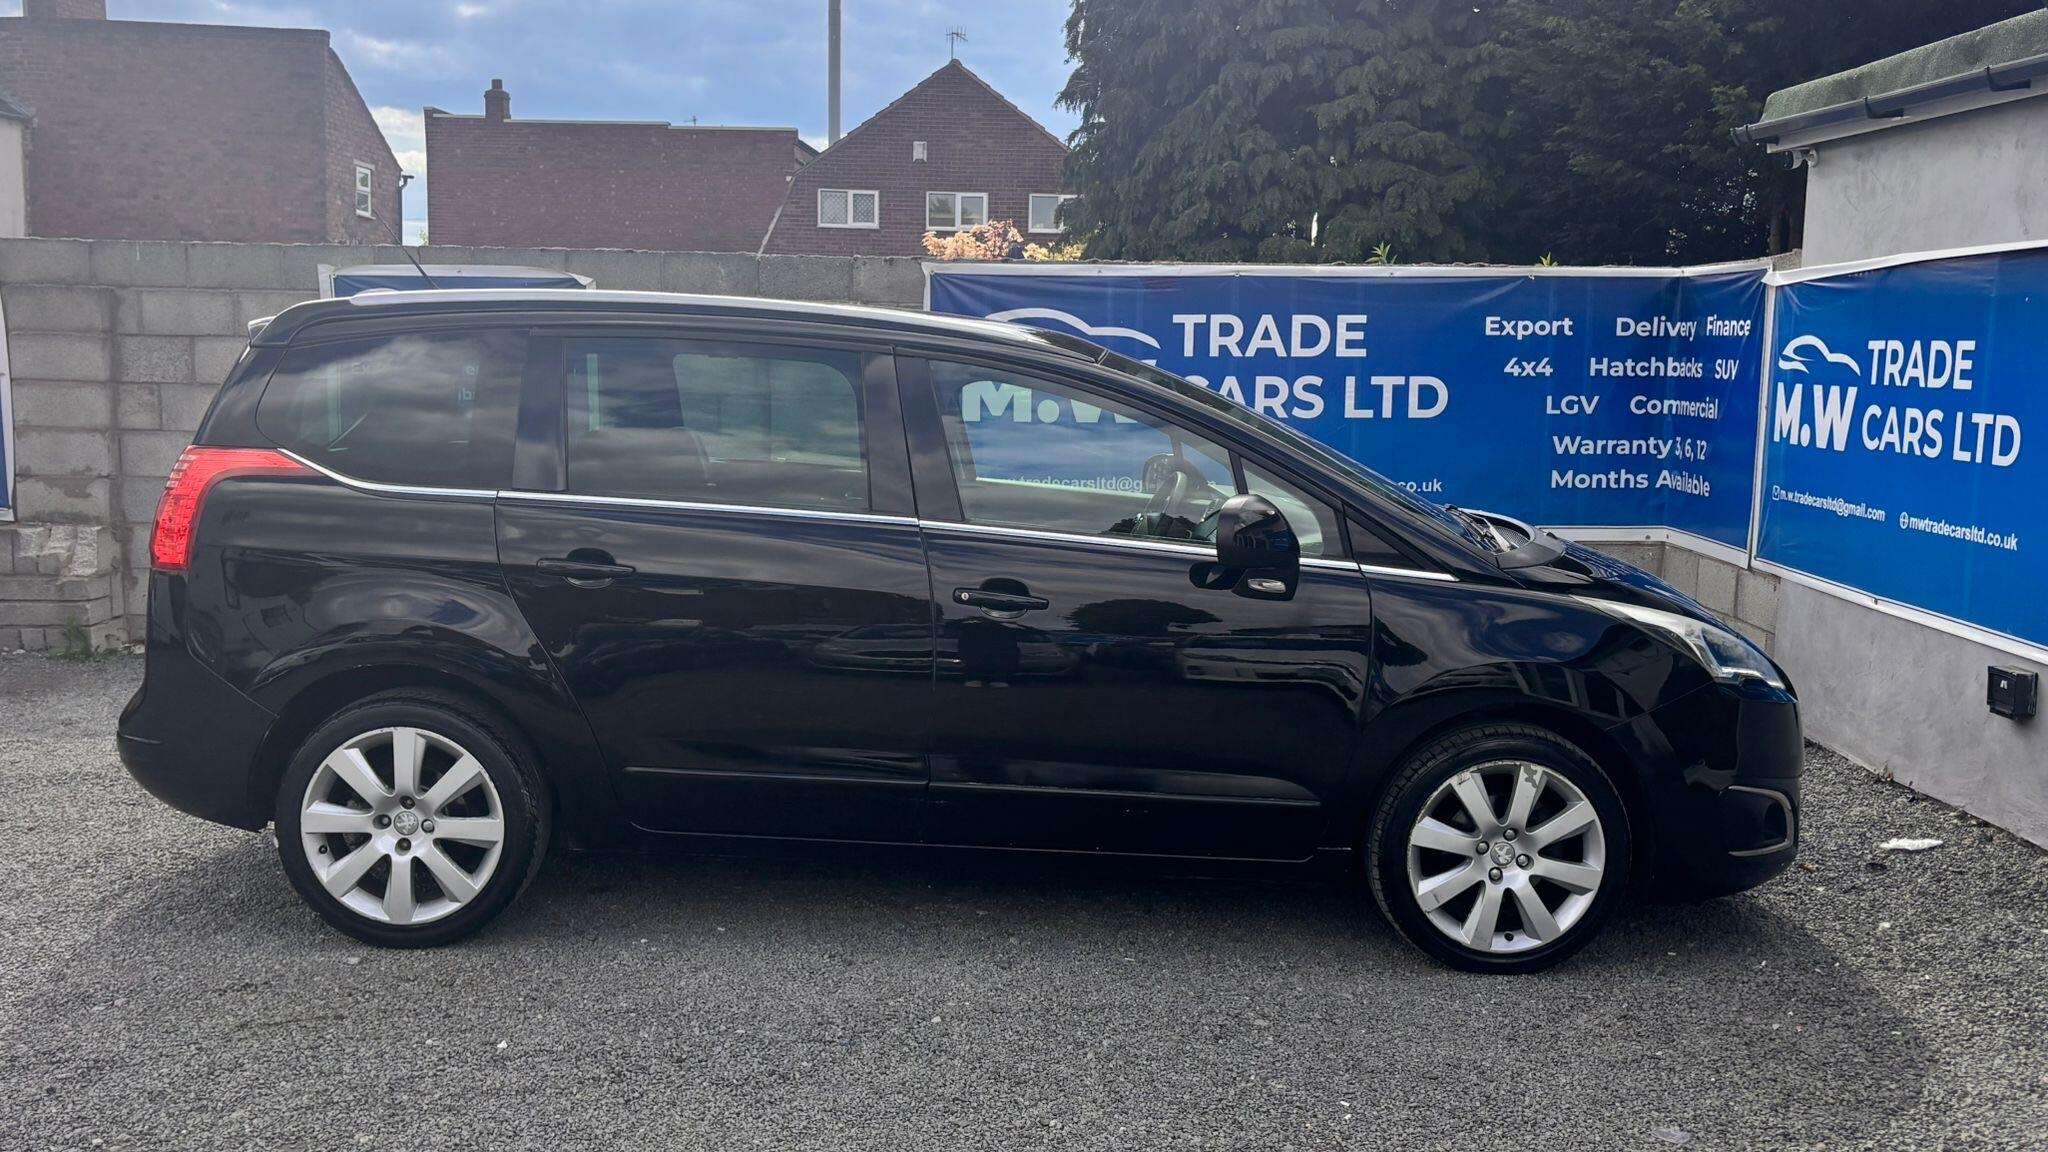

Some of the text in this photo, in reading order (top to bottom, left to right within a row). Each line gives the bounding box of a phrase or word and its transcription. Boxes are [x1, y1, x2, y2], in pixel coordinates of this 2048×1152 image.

[1172, 314, 1367, 357] TRADE
[1485, 314, 1751, 341] Export Delivery Finance
[1504, 358, 1553, 376] 4x4
[1590, 357, 1702, 378] Hatchbacks
[1868, 340, 1976, 390] TRADE
[1344, 376, 1449, 418] LTD
[1546, 395, 1718, 419] LGV Commercial
[1773, 382, 1858, 451] M.W
[1553, 435, 1673, 459] Warranty
[1697, 440, 1707, 460] 12
[1861, 404, 2021, 467] CARS LTD
[1551, 469, 1710, 497] Months Available
[1780, 489, 1885, 521] m.w.tradecarsltd@gmail.com
[1909, 516, 2018, 551] mwtradecarsltd.co.uk
